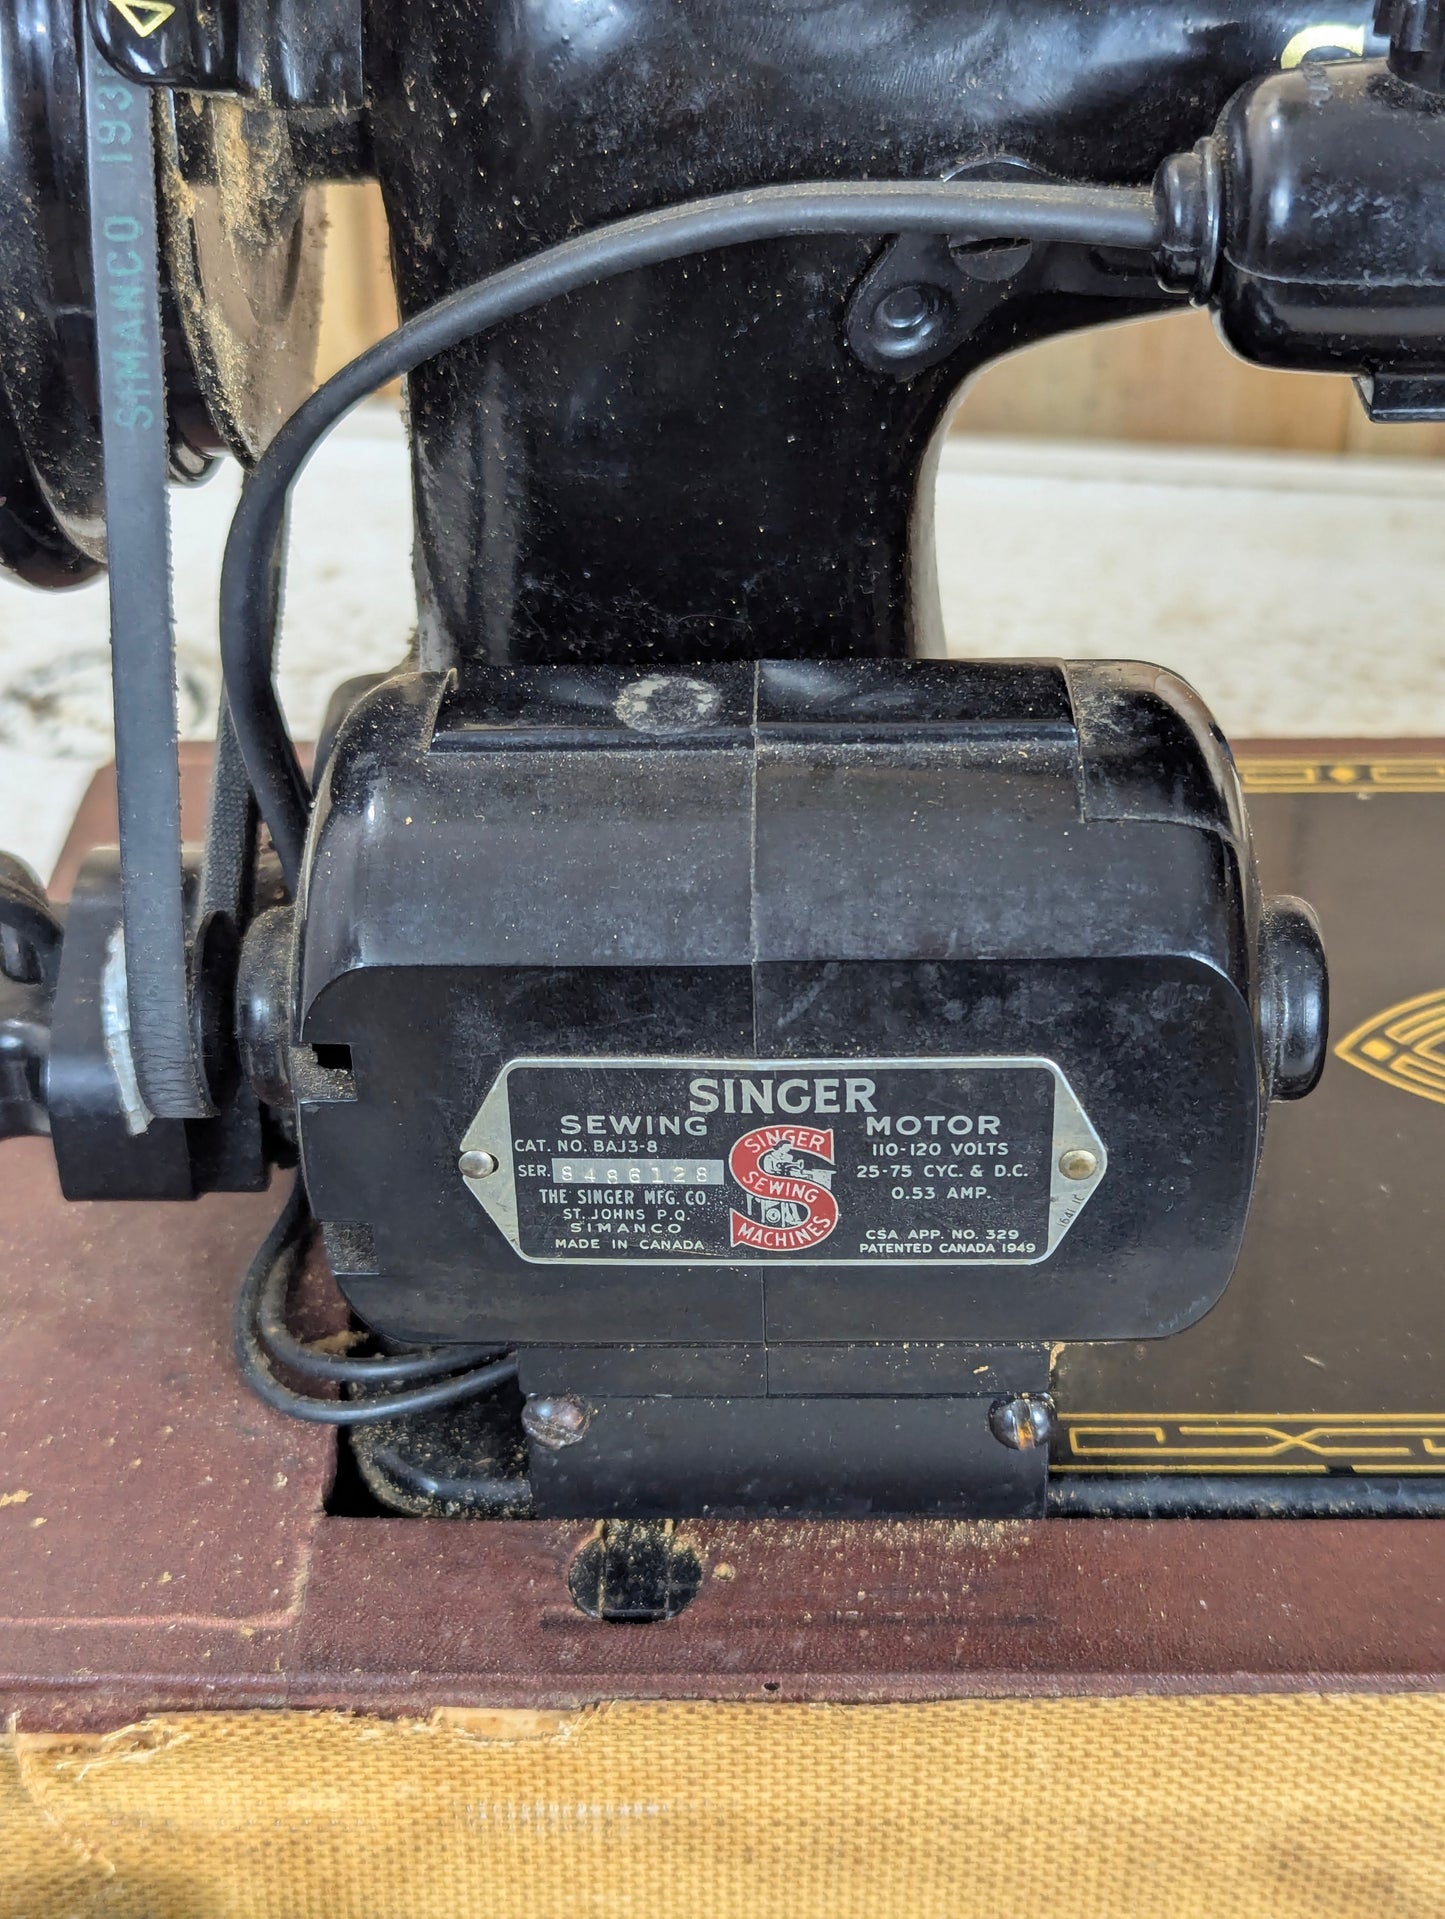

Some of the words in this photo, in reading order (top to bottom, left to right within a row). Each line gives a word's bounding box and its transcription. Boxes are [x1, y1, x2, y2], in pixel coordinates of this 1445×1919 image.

[103, 215, 153, 431] SIMANCO
[689, 1078, 877, 1114] SINGER
[560, 1115, 708, 1136] SEWING
[866, 1115, 1001, 1136] MOTOR
[514, 1139, 551, 1152] CAT.
[557, 1139, 588, 1153] NO.
[593, 1140, 658, 1153] BAJ3-8
[744, 1129, 825, 1154] SINGER
[872, 1143, 942, 1156] 110-120
[950, 1143, 1009, 1156] VOLTS
[517, 1164, 551, 1177] SER.
[856, 1165, 912, 1178] 25-75
[923, 1165, 963, 1178] CYC.
[969, 1165, 984, 1178] &
[994, 1165, 1028, 1178] D.C.
[742, 1170, 820, 1204] SEWING
[891, 1187, 936, 1200] 0.53
[946, 1187, 991, 1200] AMP.
[539, 1189, 568, 1204] THE
[577, 1189, 634, 1205] SINGER
[644, 1190, 680, 1205] MFG.
[685, 1191, 711, 1206] CO.
[563, 1209, 586, 1221] ST.
[592, 1209, 646, 1221] JOHNS
[657, 1209, 691, 1221] P.Q.
[570, 1222, 682, 1234] SIMANCO
[737, 1215, 831, 1247] MACHINES
[865, 1230, 900, 1240] CSA
[907, 1230, 944, 1240] APP.
[951, 1230, 978, 1240] NO.
[985, 1230, 1019, 1240] 329
[555, 1239, 600, 1250] MADE
[612, 1239, 628, 1250] IN
[639, 1239, 705, 1250] CANADA
[859, 1243, 933, 1254] PATENTED
[939, 1243, 996, 1254] CANADA
[1002, 1243, 1036, 1254] 1949
